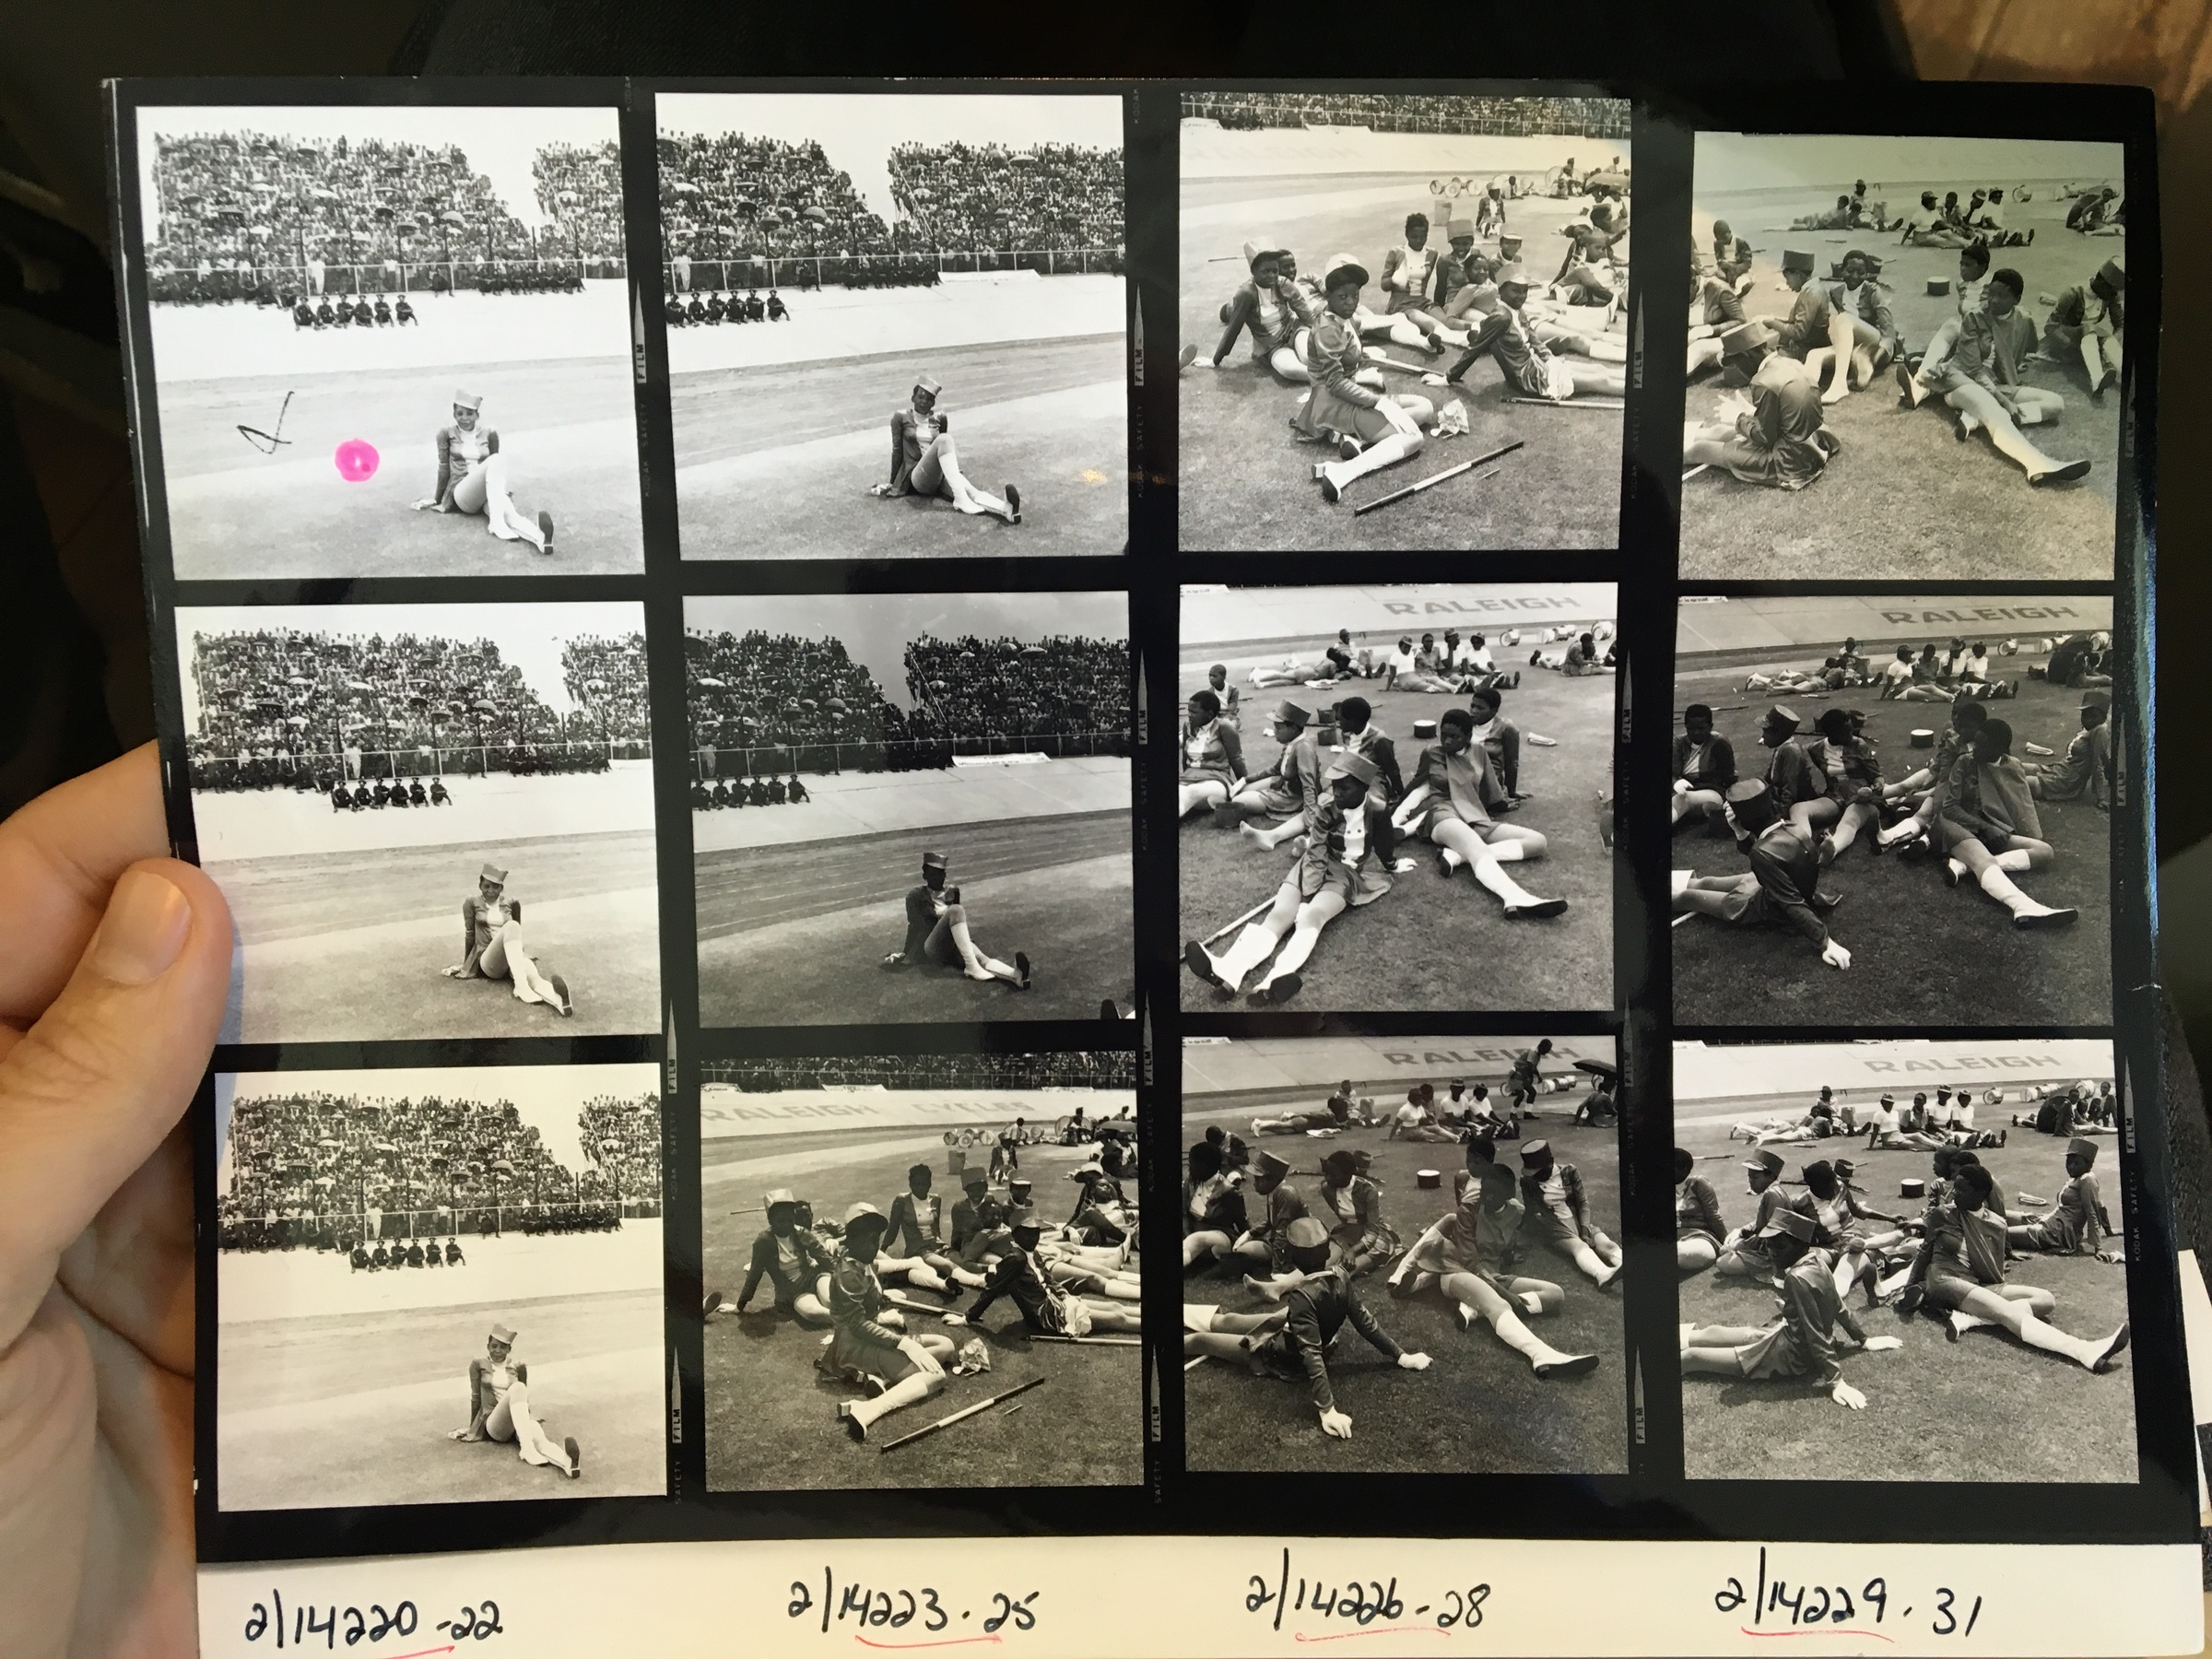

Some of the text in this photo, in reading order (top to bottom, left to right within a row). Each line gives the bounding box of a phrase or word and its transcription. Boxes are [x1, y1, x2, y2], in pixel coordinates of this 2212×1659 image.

[636, 344, 645, 380] FILM
[1135, 348, 1143, 382] FILM
[1633, 351, 1642, 385] FILM
[1135, 405, 1144, 451] SAFETY
[1384, 596, 1581, 616] RALEIGH
[1880, 606, 2078, 624] RALEIGH
[1138, 710, 1147, 741] FILM
[1623, 709, 1631, 742] FILM
[1139, 761, 1147, 805] SAFETY
[1622, 760, 1630, 804] SAFETY
[1144, 1051, 1152, 1083] FILM
[1383, 1047, 1582, 1065] RALEIH
[1864, 1055, 2061, 1073] RALEIGH
[668, 1058, 677, 1090] FILM
[701, 1104, 880, 1122] RALEIGH
[669, 1112, 677, 1155] SAFETY
[2126, 1117, 2141, 1262] KODAK SAFETY FILM
[1635, 1406, 1644, 1441] FILM
[673, 1408, 682, 1504] SAFETY FILM
[1151, 1406, 1161, 1504] SAFETY FILM
